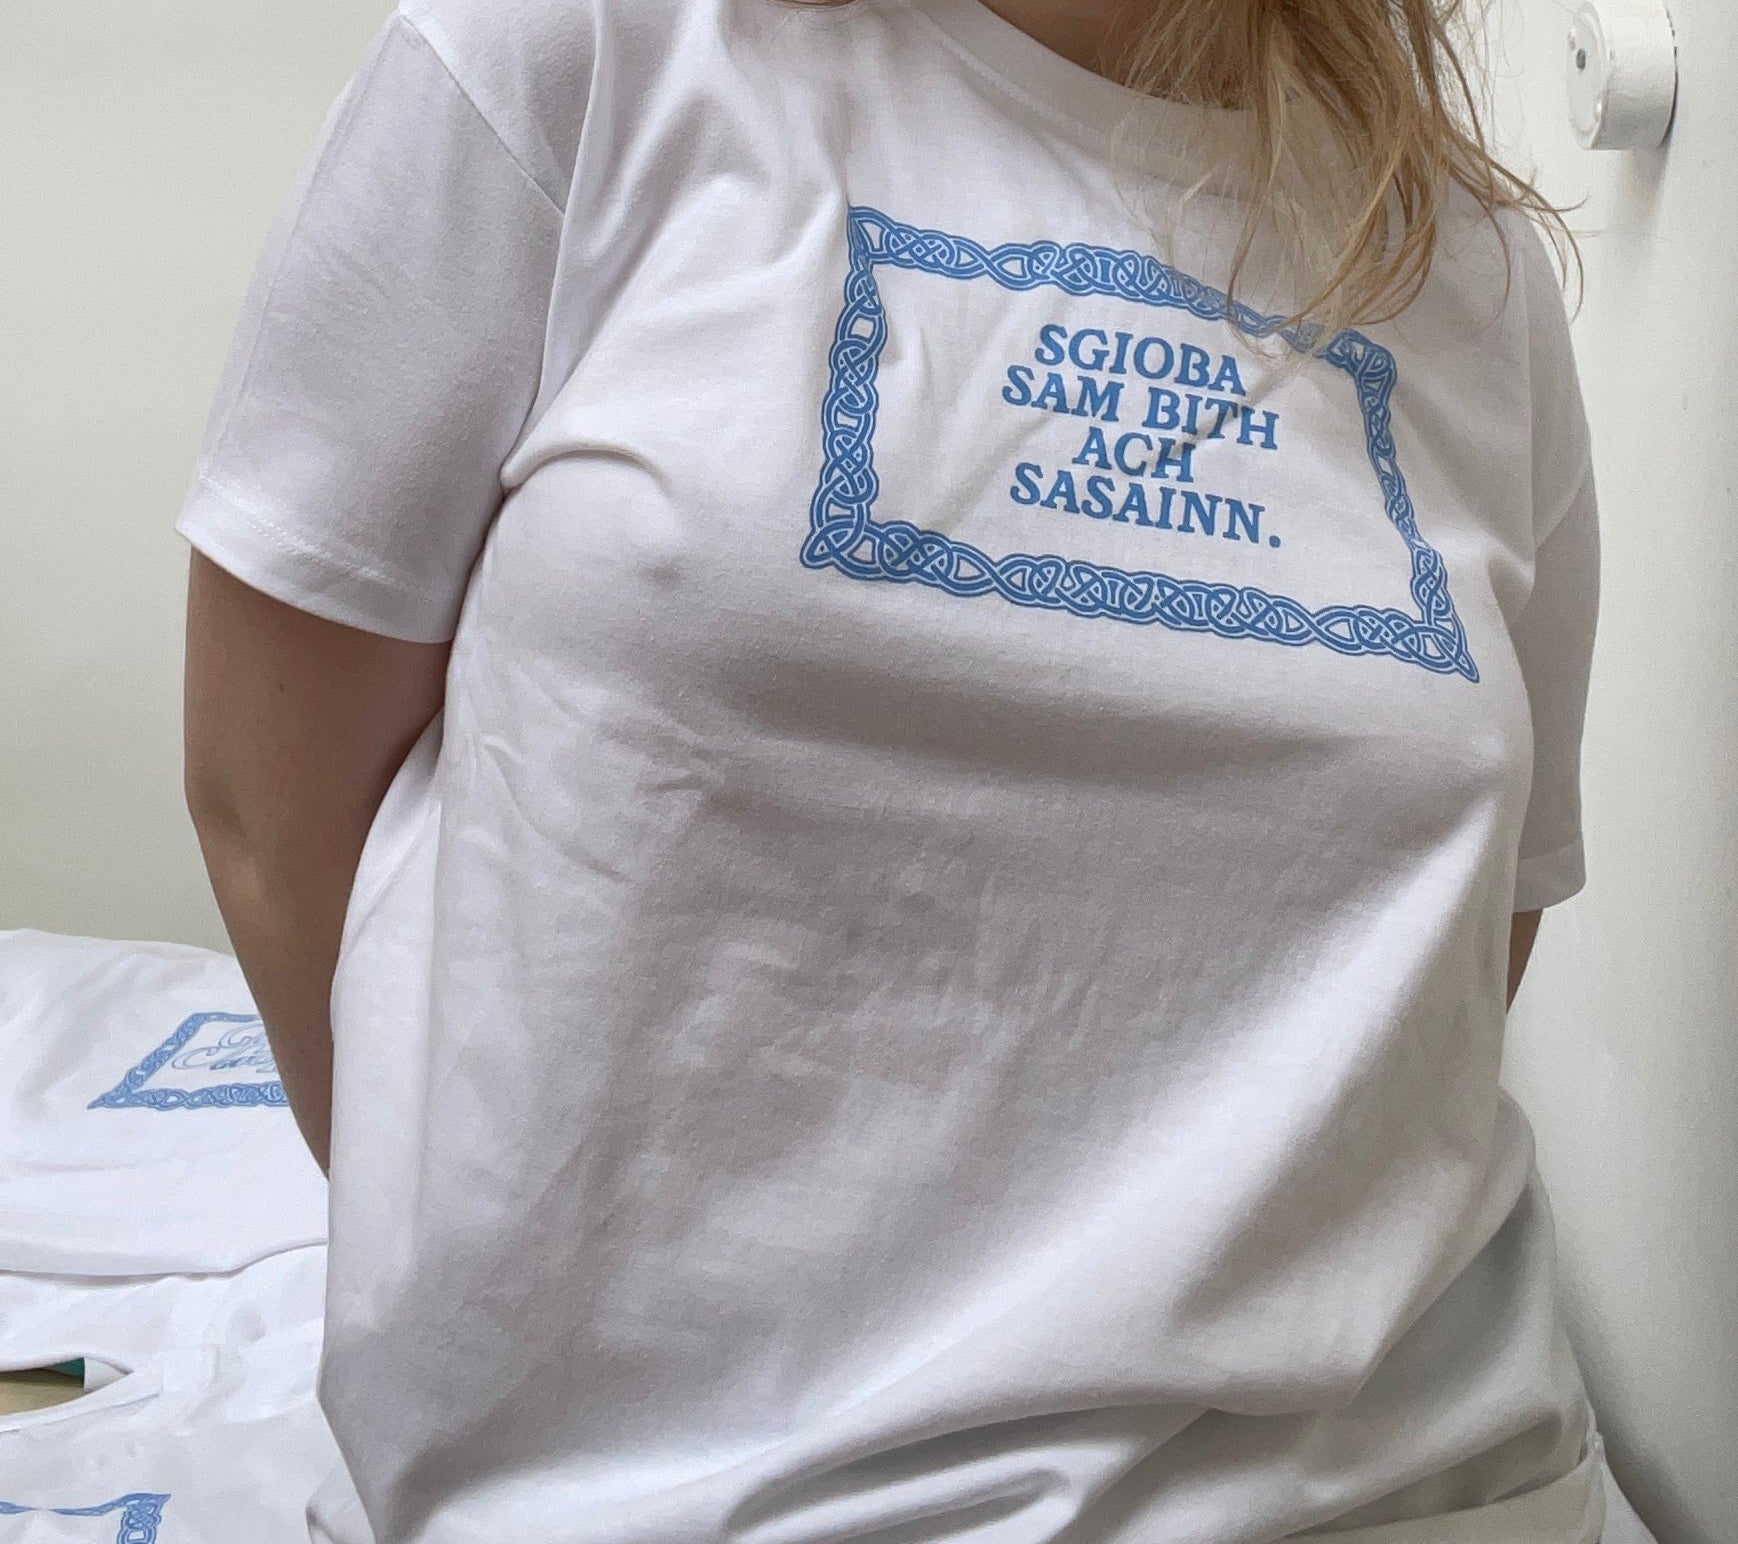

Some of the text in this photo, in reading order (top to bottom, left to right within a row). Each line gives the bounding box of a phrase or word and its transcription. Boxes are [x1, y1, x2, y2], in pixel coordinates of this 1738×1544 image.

[1035, 324, 1246, 396] SGIOBA
[1002, 365, 1278, 451] SAM BITH
[1073, 427, 1195, 485] ACH
[1010, 462, 1281, 548] SASAINN.
